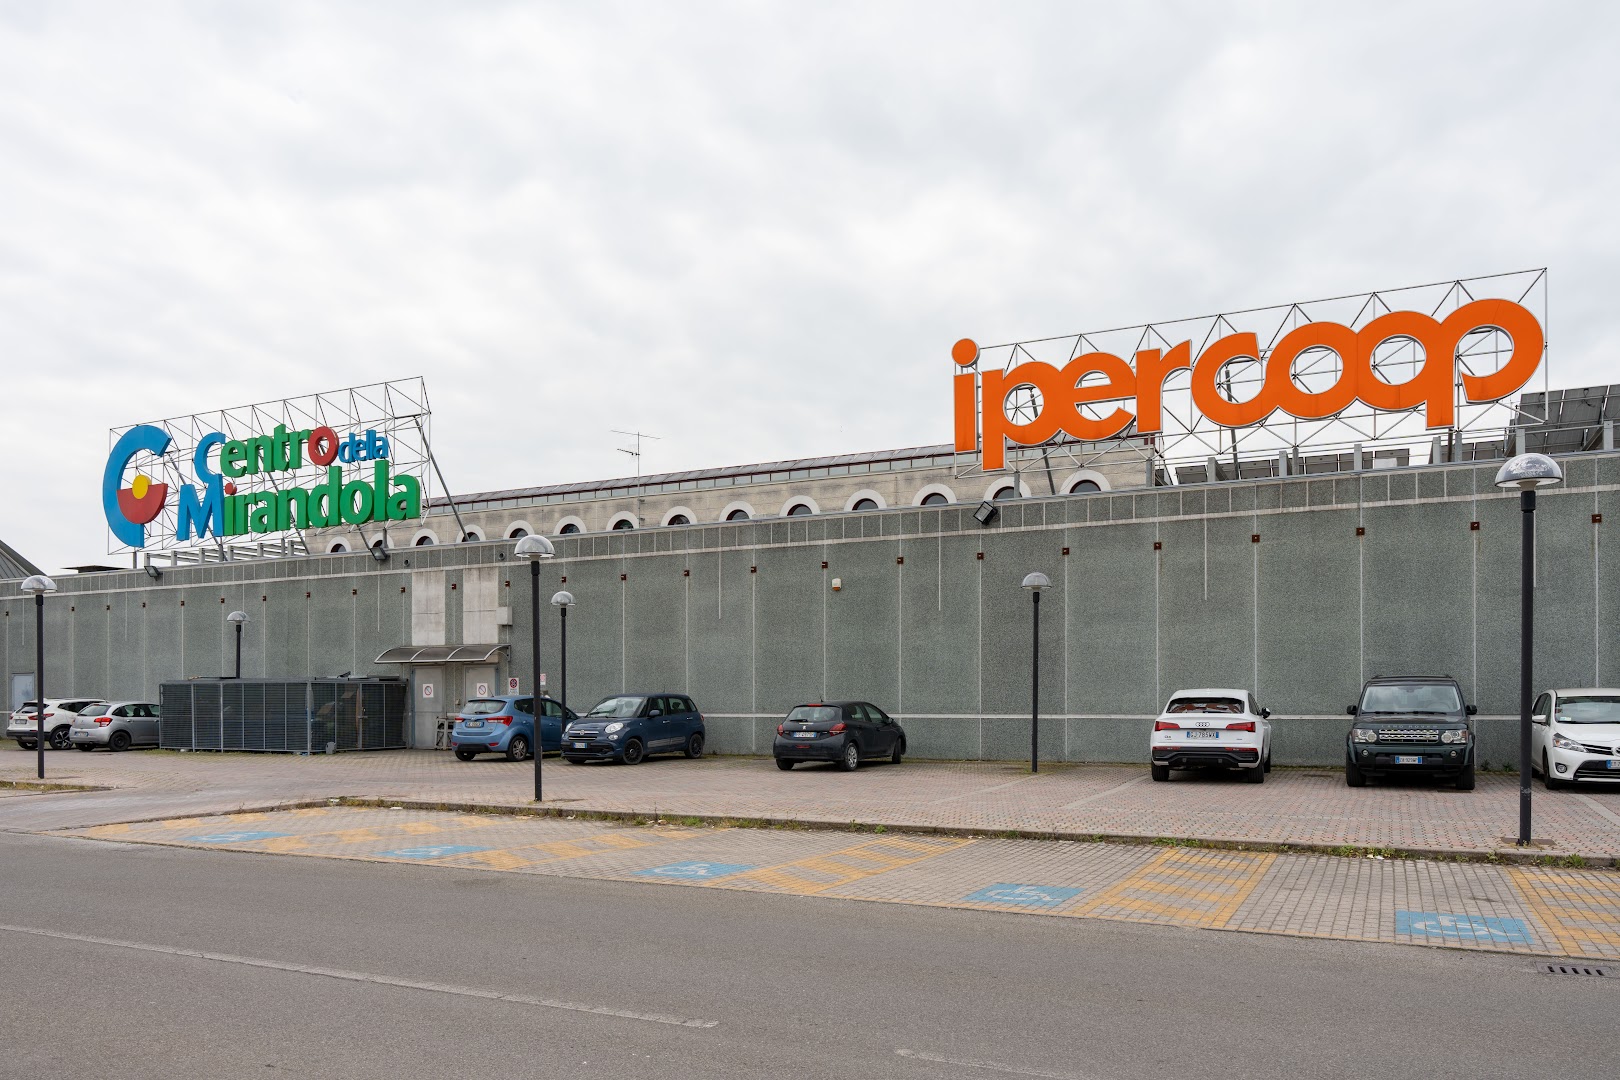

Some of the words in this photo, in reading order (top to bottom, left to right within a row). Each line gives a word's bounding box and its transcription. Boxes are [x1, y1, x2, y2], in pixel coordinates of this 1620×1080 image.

[951, 298, 1545, 471] ipercoop
[194, 423, 340, 484] Centro
[338, 429, 389, 464] della
[176, 460, 421, 541] Mirandola
